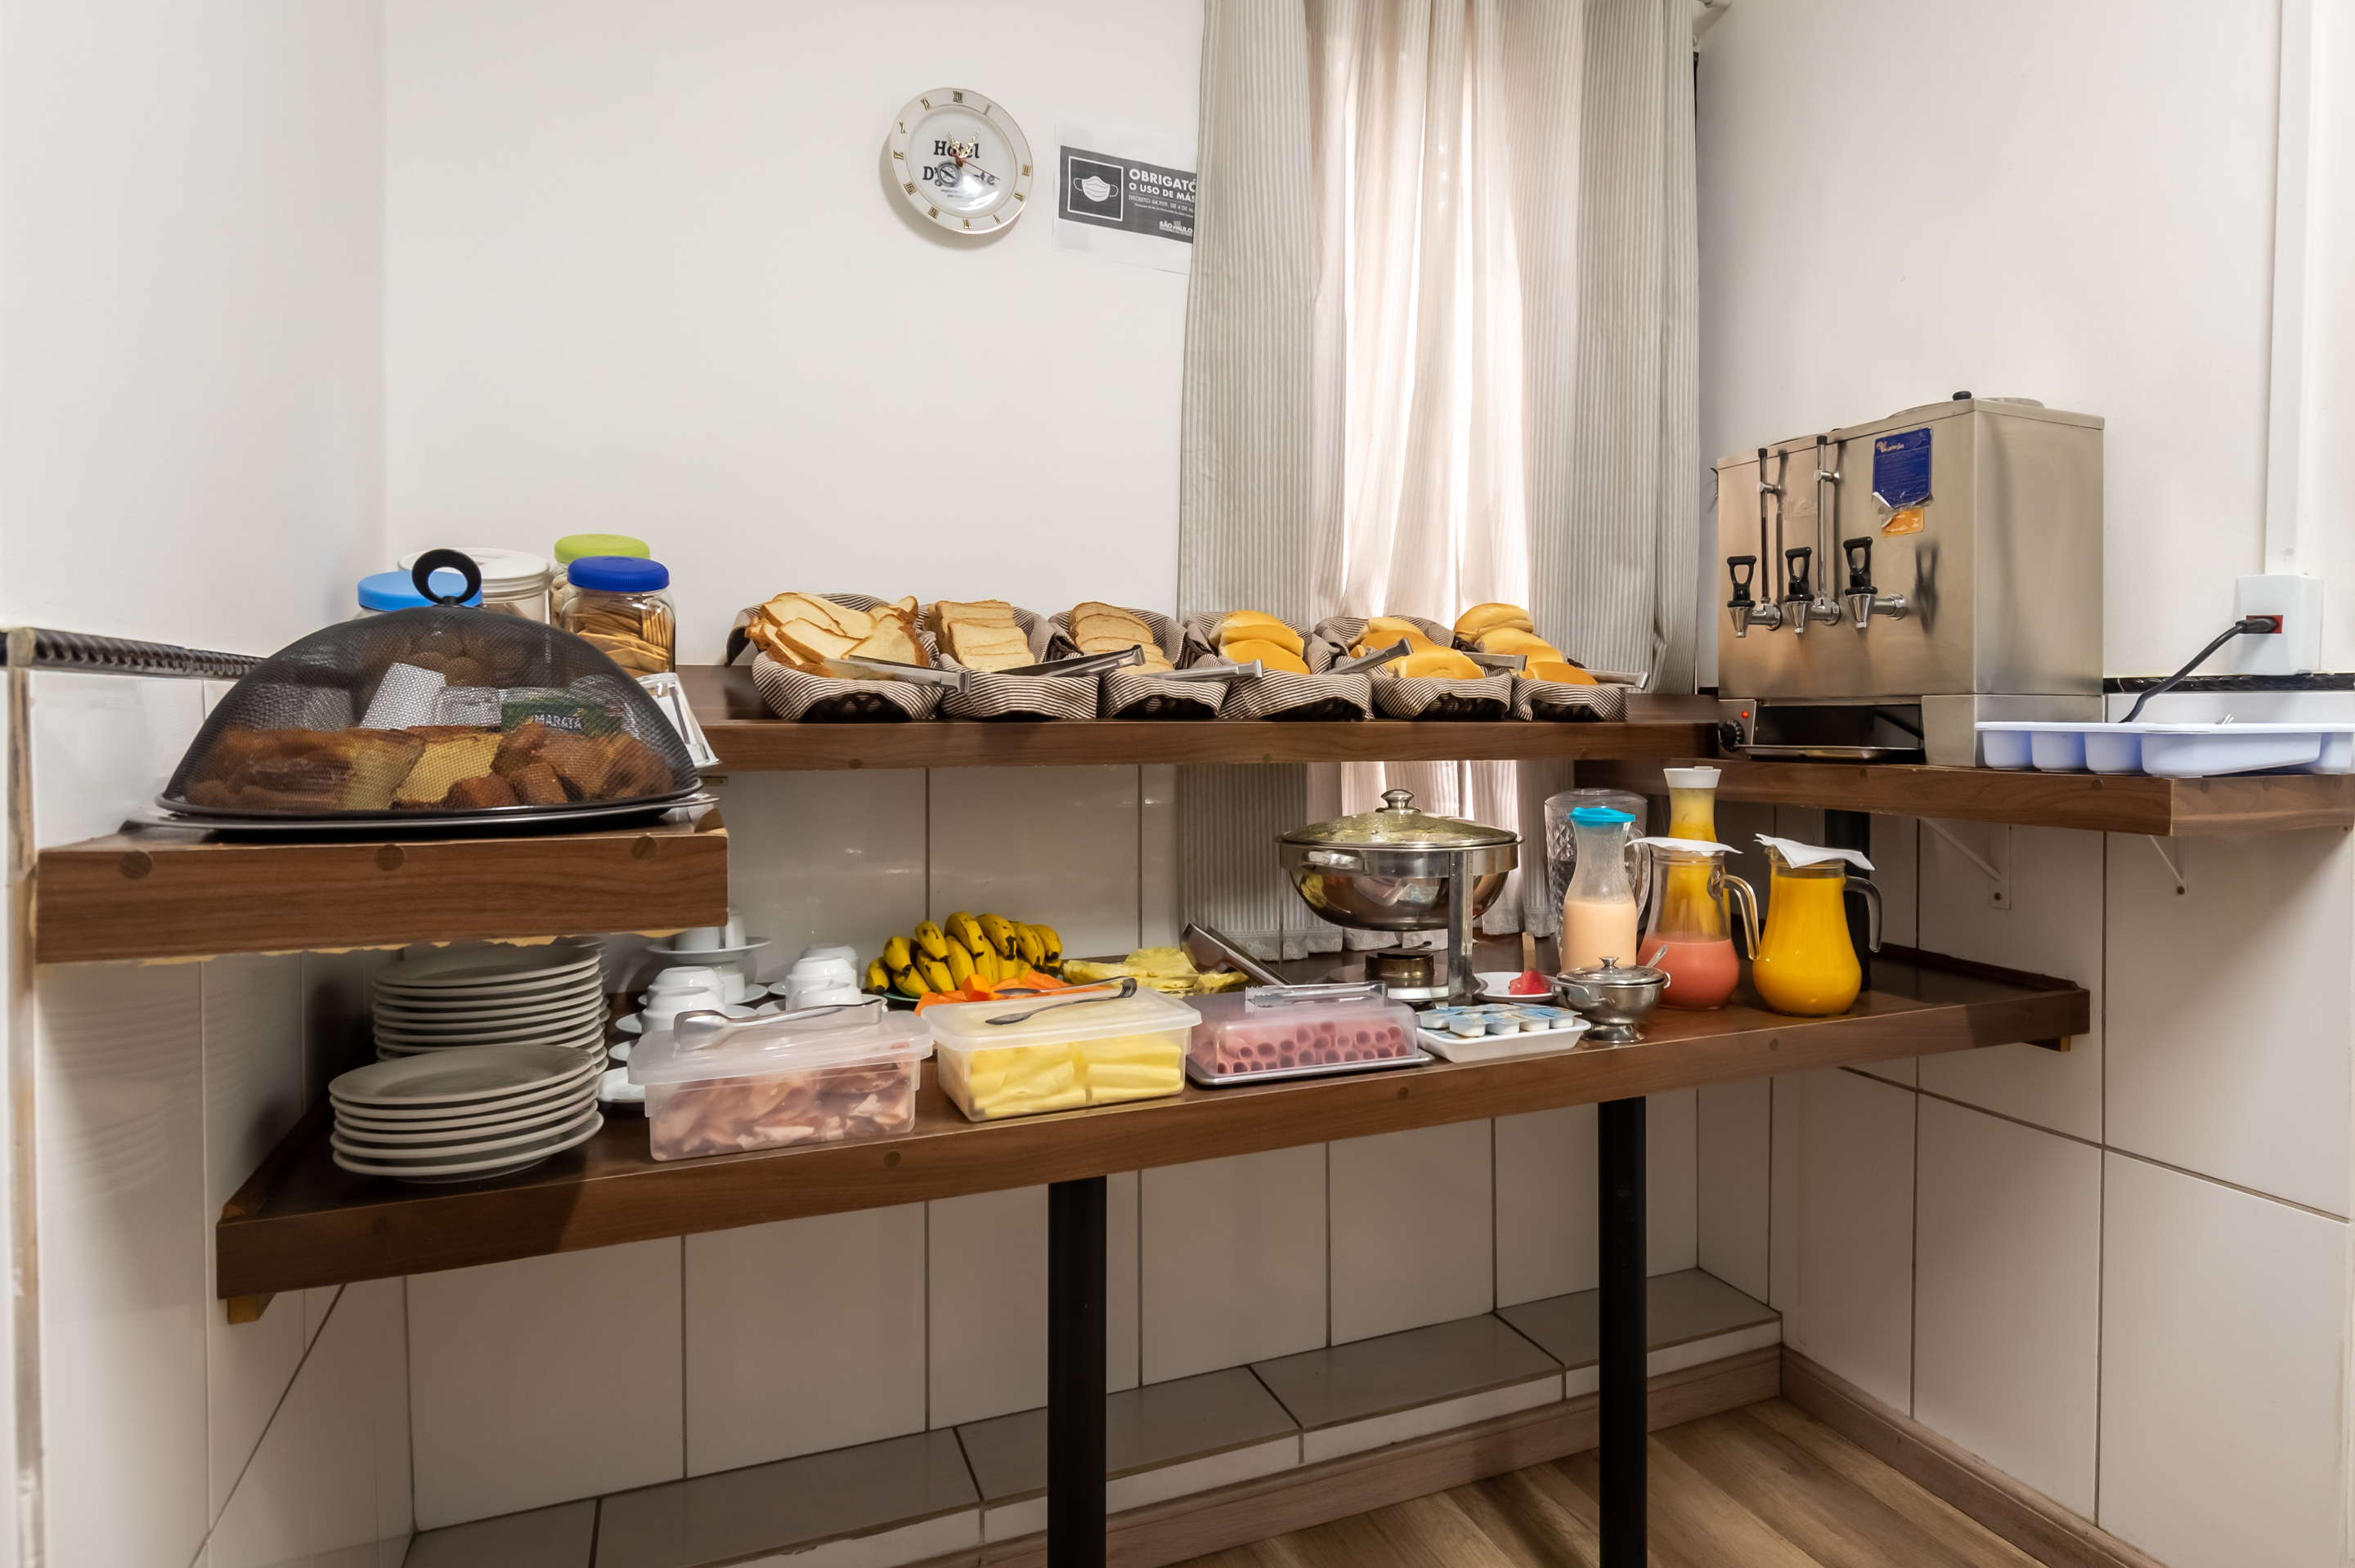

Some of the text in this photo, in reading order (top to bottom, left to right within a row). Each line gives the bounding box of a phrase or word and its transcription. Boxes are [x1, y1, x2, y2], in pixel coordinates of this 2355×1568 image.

[1128, 182, 1137, 190] O
[1140, 184, 1160, 195] USO
[1163, 189, 1173, 198] DE
[1128, 195, 1151, 203] DECRETO
[1159, 221, 1193, 234] SÃO PAULO
